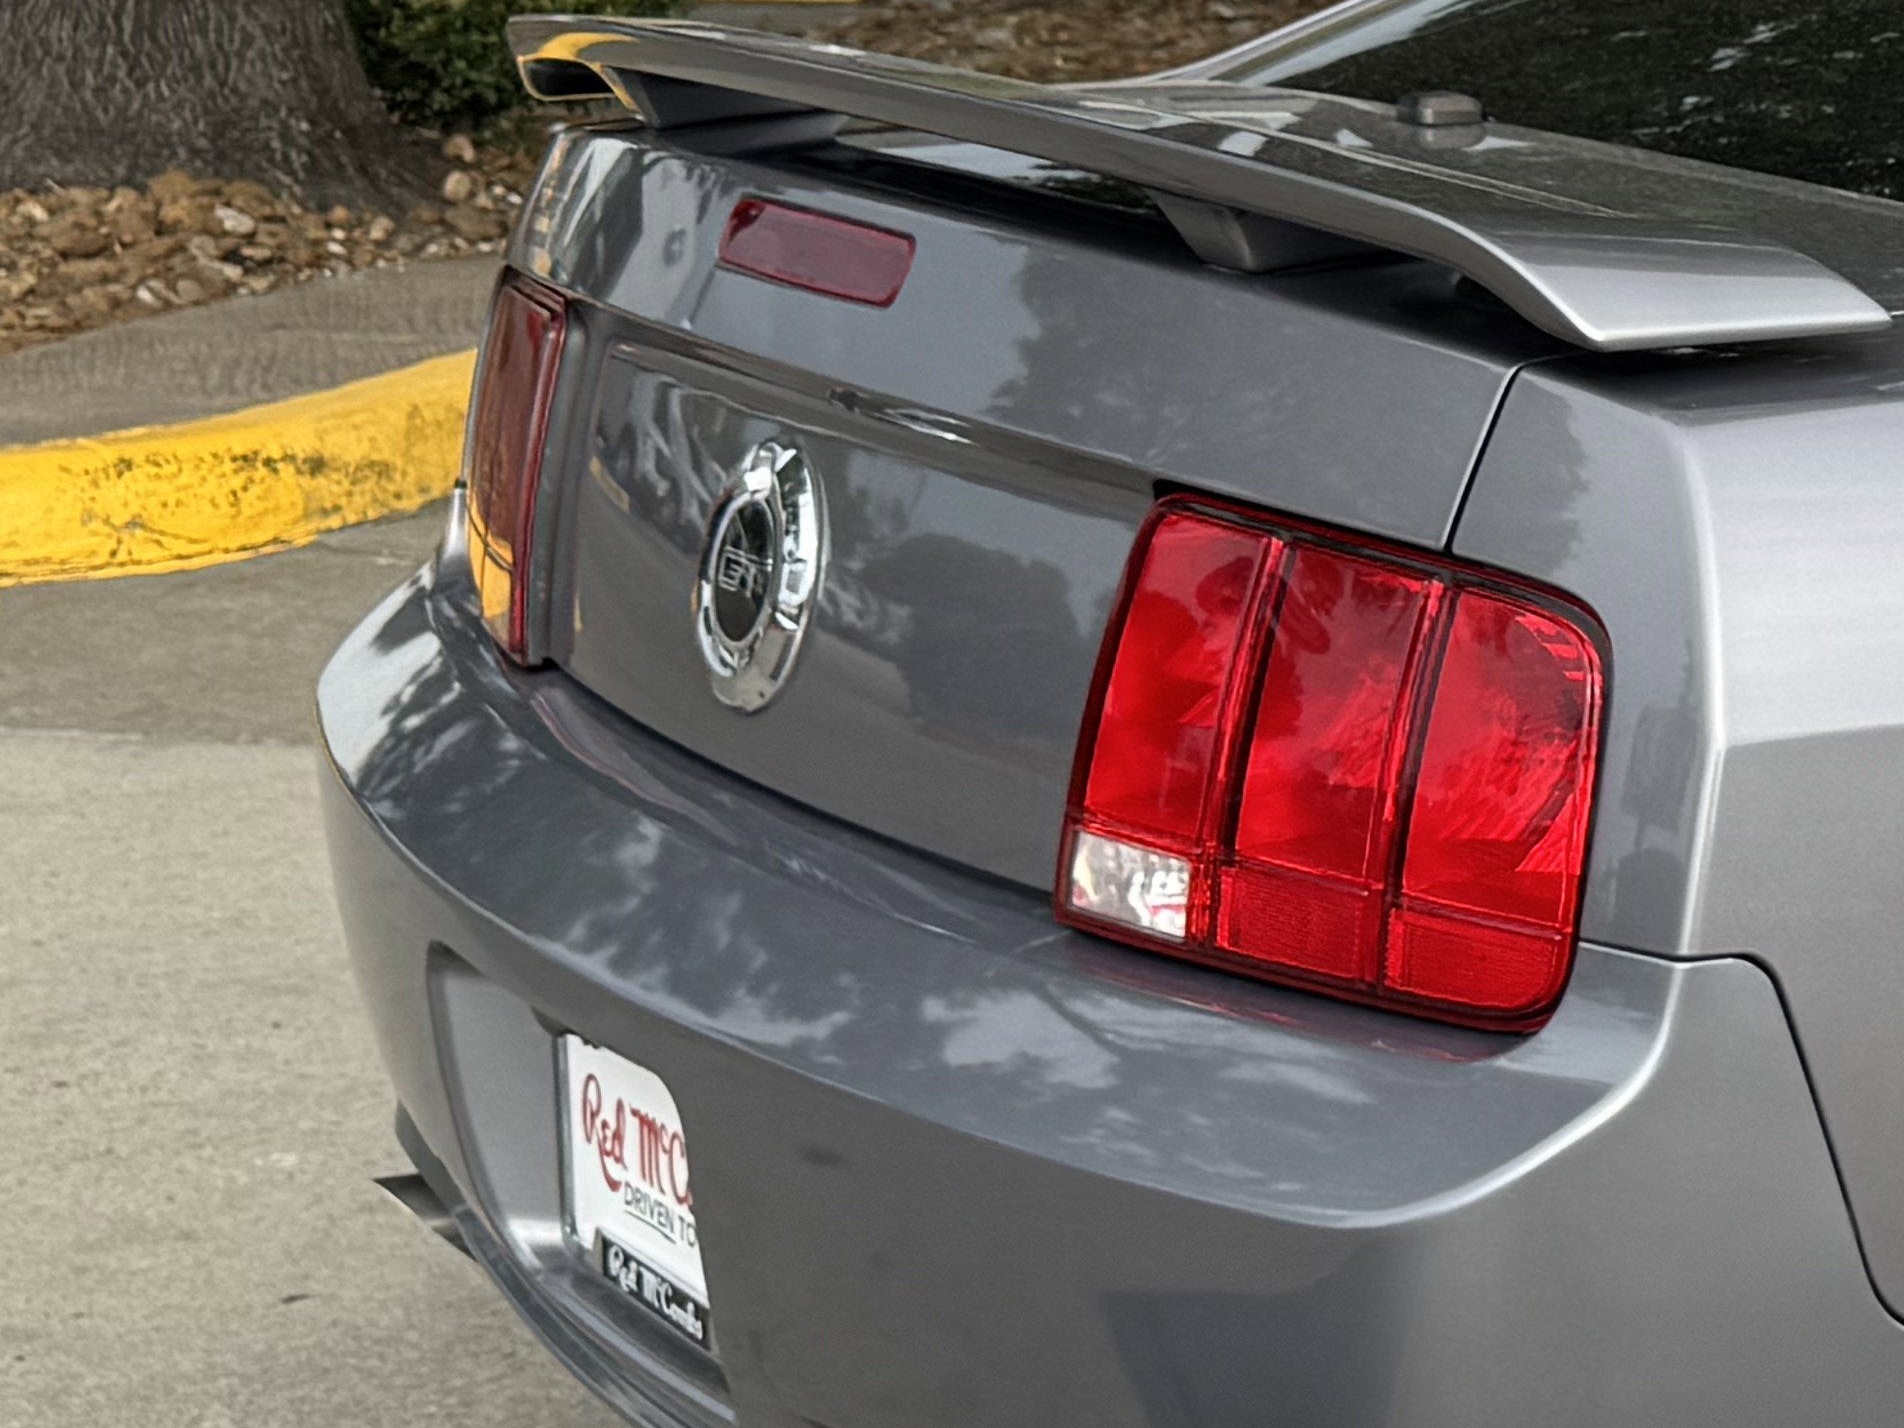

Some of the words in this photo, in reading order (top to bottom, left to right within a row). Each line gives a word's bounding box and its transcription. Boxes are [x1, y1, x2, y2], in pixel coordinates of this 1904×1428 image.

[583, 1073, 628, 1192] Red
[629, 1104, 693, 1206] McC
[624, 1180, 676, 1235] DRIVEN
[678, 1215, 697, 1248] TO
